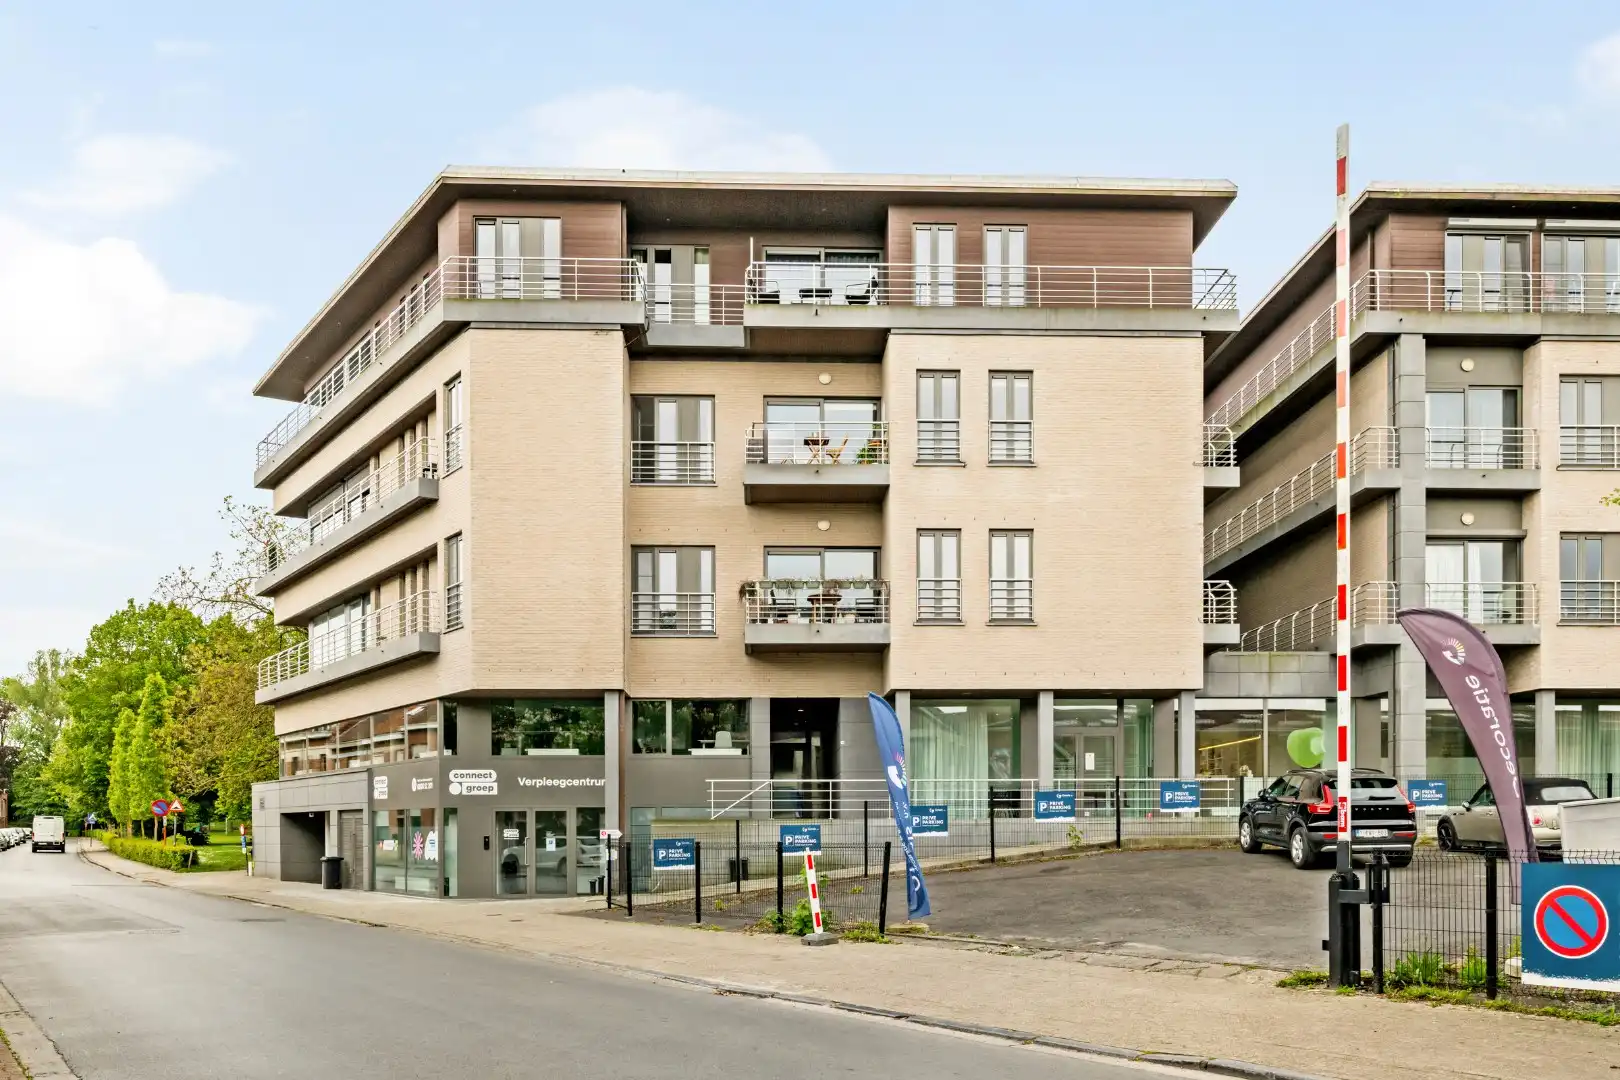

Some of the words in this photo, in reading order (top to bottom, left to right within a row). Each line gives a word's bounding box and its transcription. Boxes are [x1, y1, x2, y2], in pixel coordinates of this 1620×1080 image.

[453, 771, 493, 779] connect
[466, 784, 494, 793] groep
[1165, 792, 1173, 802] P
[1412, 790, 1420, 800] P
[1039, 802, 1048, 812] P
[912, 816, 920, 826] P
[785, 836, 793, 846] P
[658, 850, 667, 860] P
